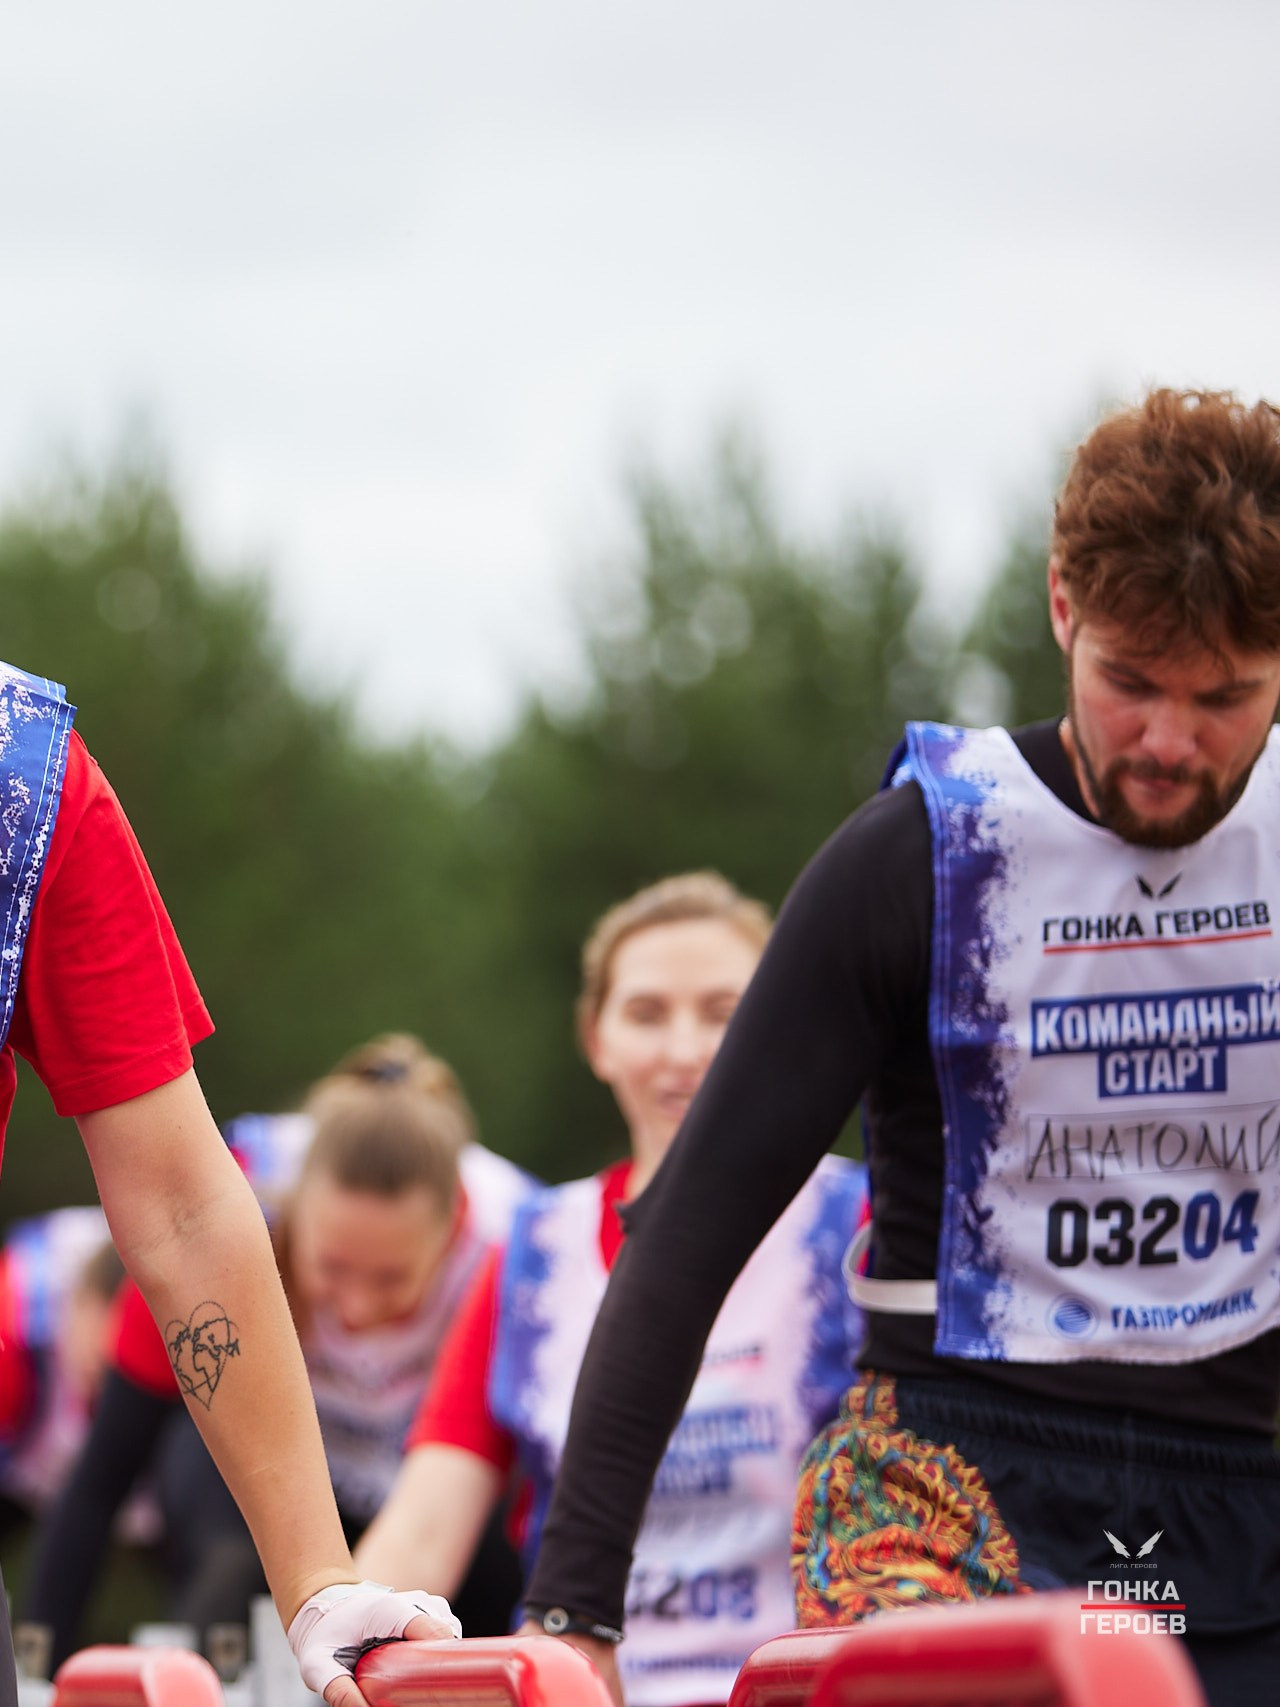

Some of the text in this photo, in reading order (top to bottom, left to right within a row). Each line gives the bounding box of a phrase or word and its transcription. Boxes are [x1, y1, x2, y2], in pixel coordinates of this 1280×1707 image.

[1043, 901, 1271, 943] ГОНКА ГЕРОЕВ
[1104, 1047, 1219, 1095] СТАРТ
[1046, 1190, 1260, 1269] 03204
